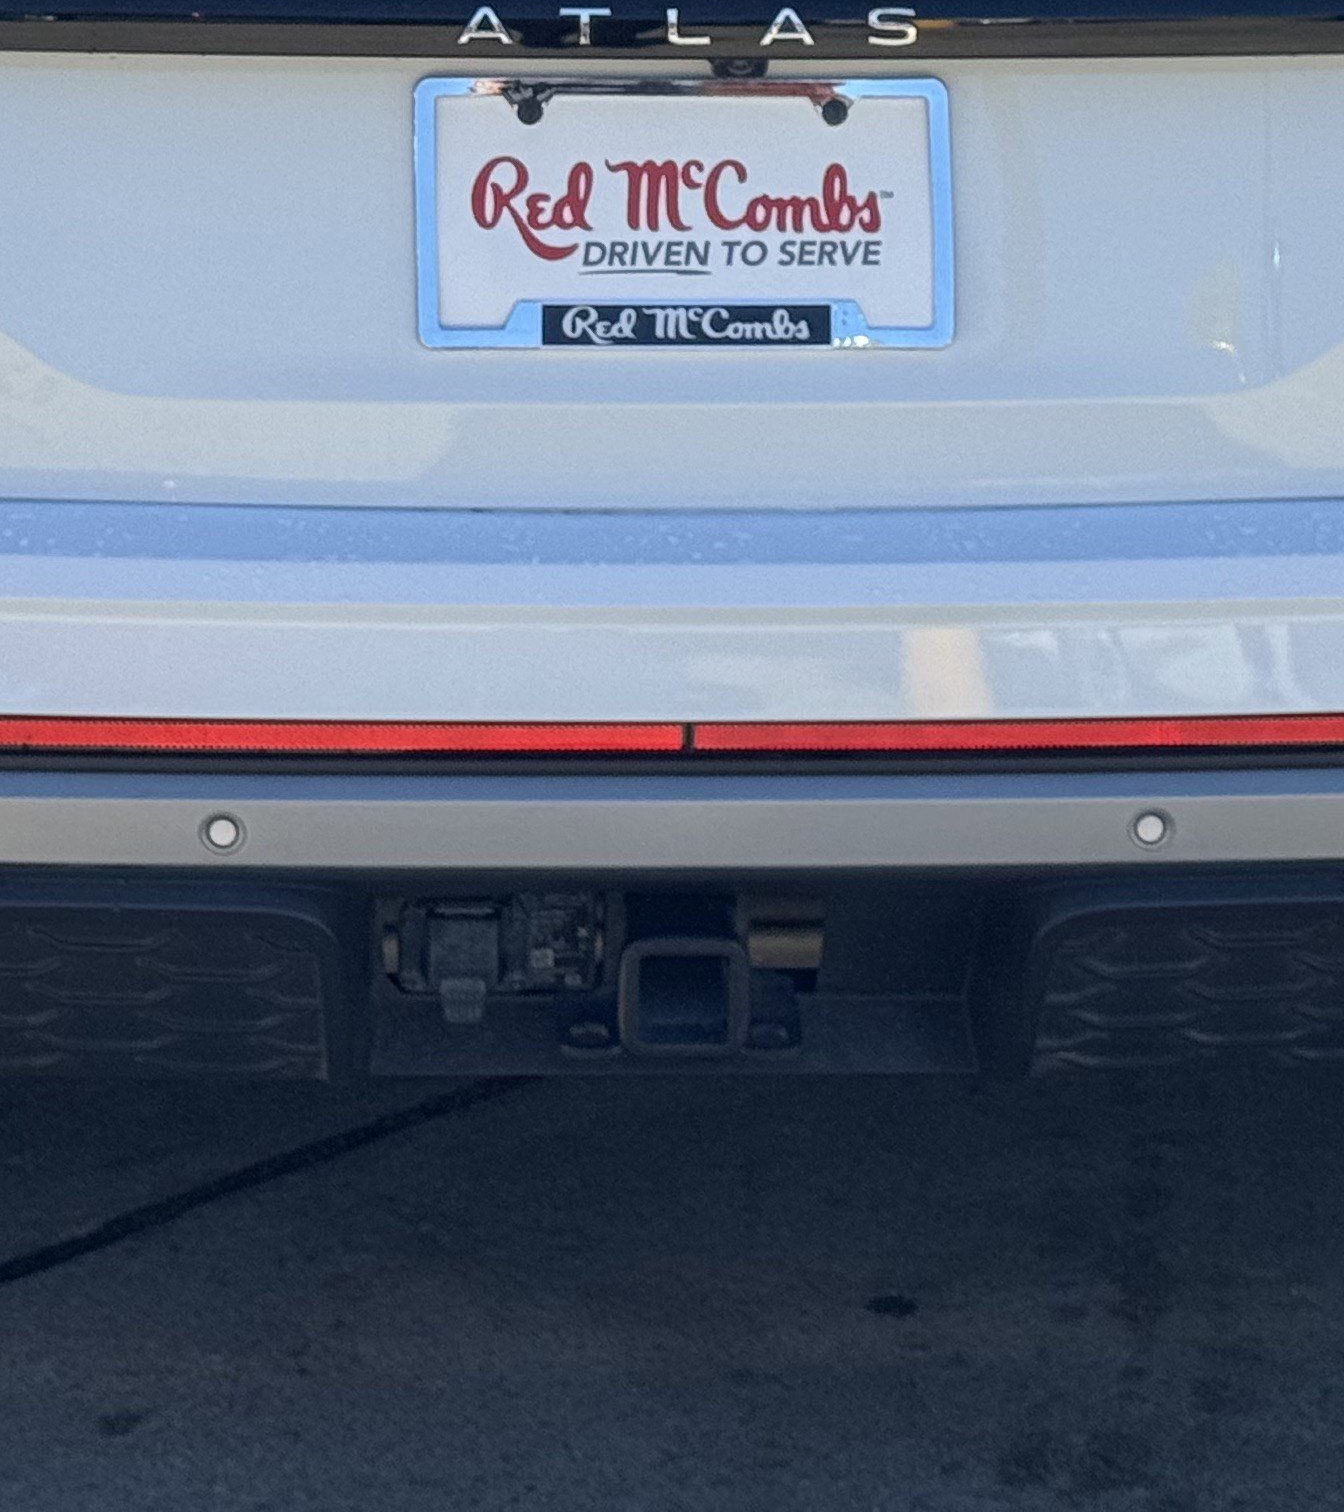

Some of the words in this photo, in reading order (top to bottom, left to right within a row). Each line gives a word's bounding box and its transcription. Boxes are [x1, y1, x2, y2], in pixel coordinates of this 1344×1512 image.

[456, 5, 918, 47] ATLAS
[470, 155, 594, 261] Red
[603, 157, 883, 233] McCombs
[581, 240, 711, 267] DRIVEN
[723, 240, 769, 267] TO
[779, 240, 883, 267] SERVE
[562, 306, 637, 346] Red
[642, 307, 812, 341] McCombs
